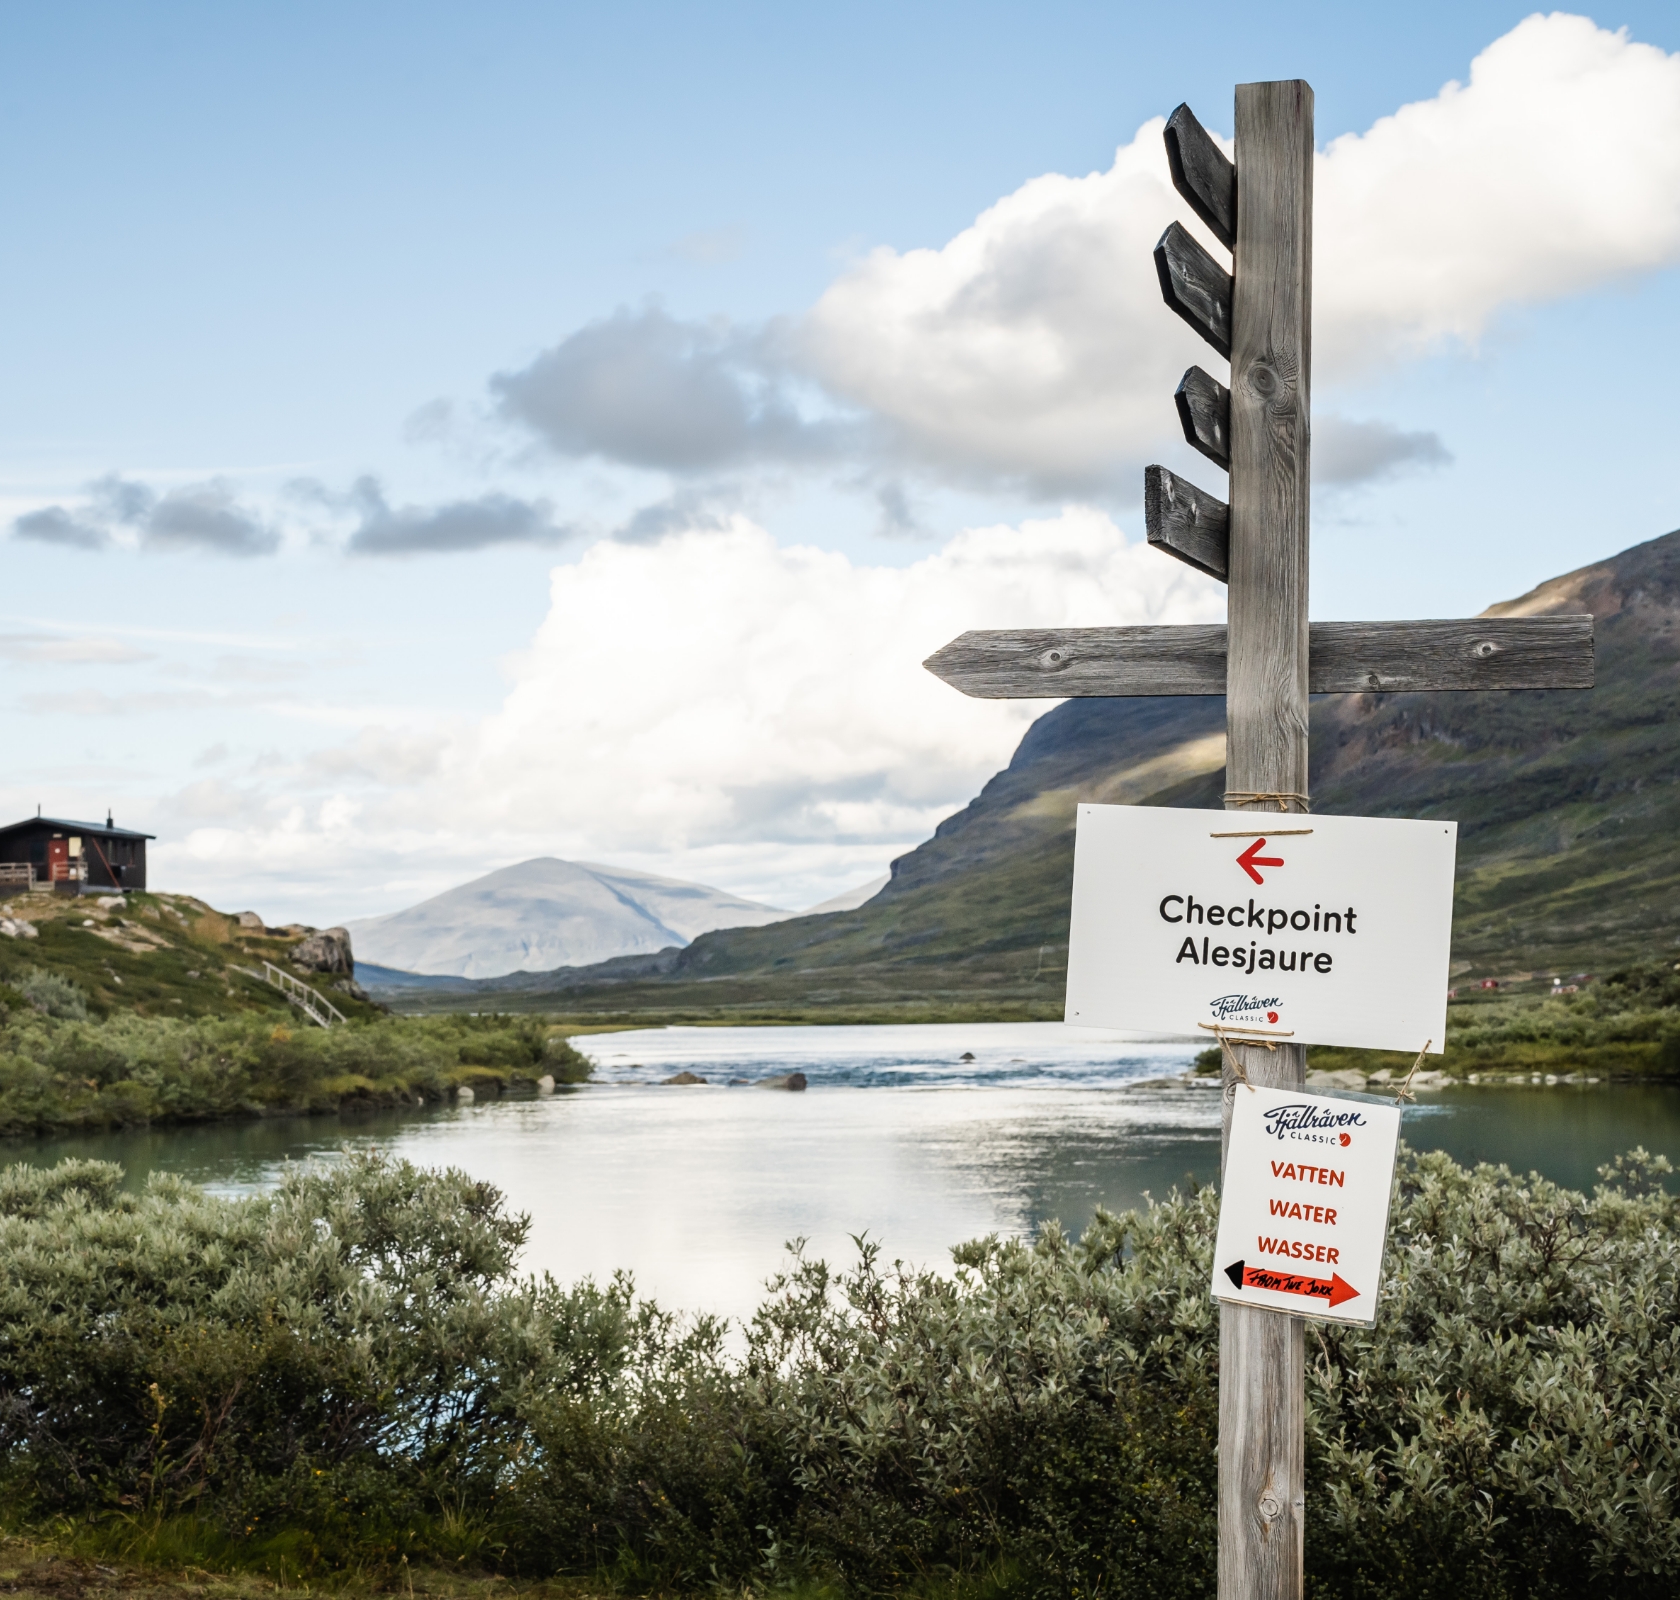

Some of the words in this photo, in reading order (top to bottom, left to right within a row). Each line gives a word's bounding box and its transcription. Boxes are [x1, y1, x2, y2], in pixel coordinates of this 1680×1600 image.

[1159, 894, 1358, 936] Checkpoint
[1175, 936, 1334, 975] Alesjaure
[1228, 1014, 1264, 1023] CLASSIC
[1290, 1131, 1337, 1146] CLASSIC
[1270, 1160, 1345, 1188] VATTEN
[1269, 1198, 1338, 1226] WATER
[1257, 1235, 1340, 1265] WASSER
